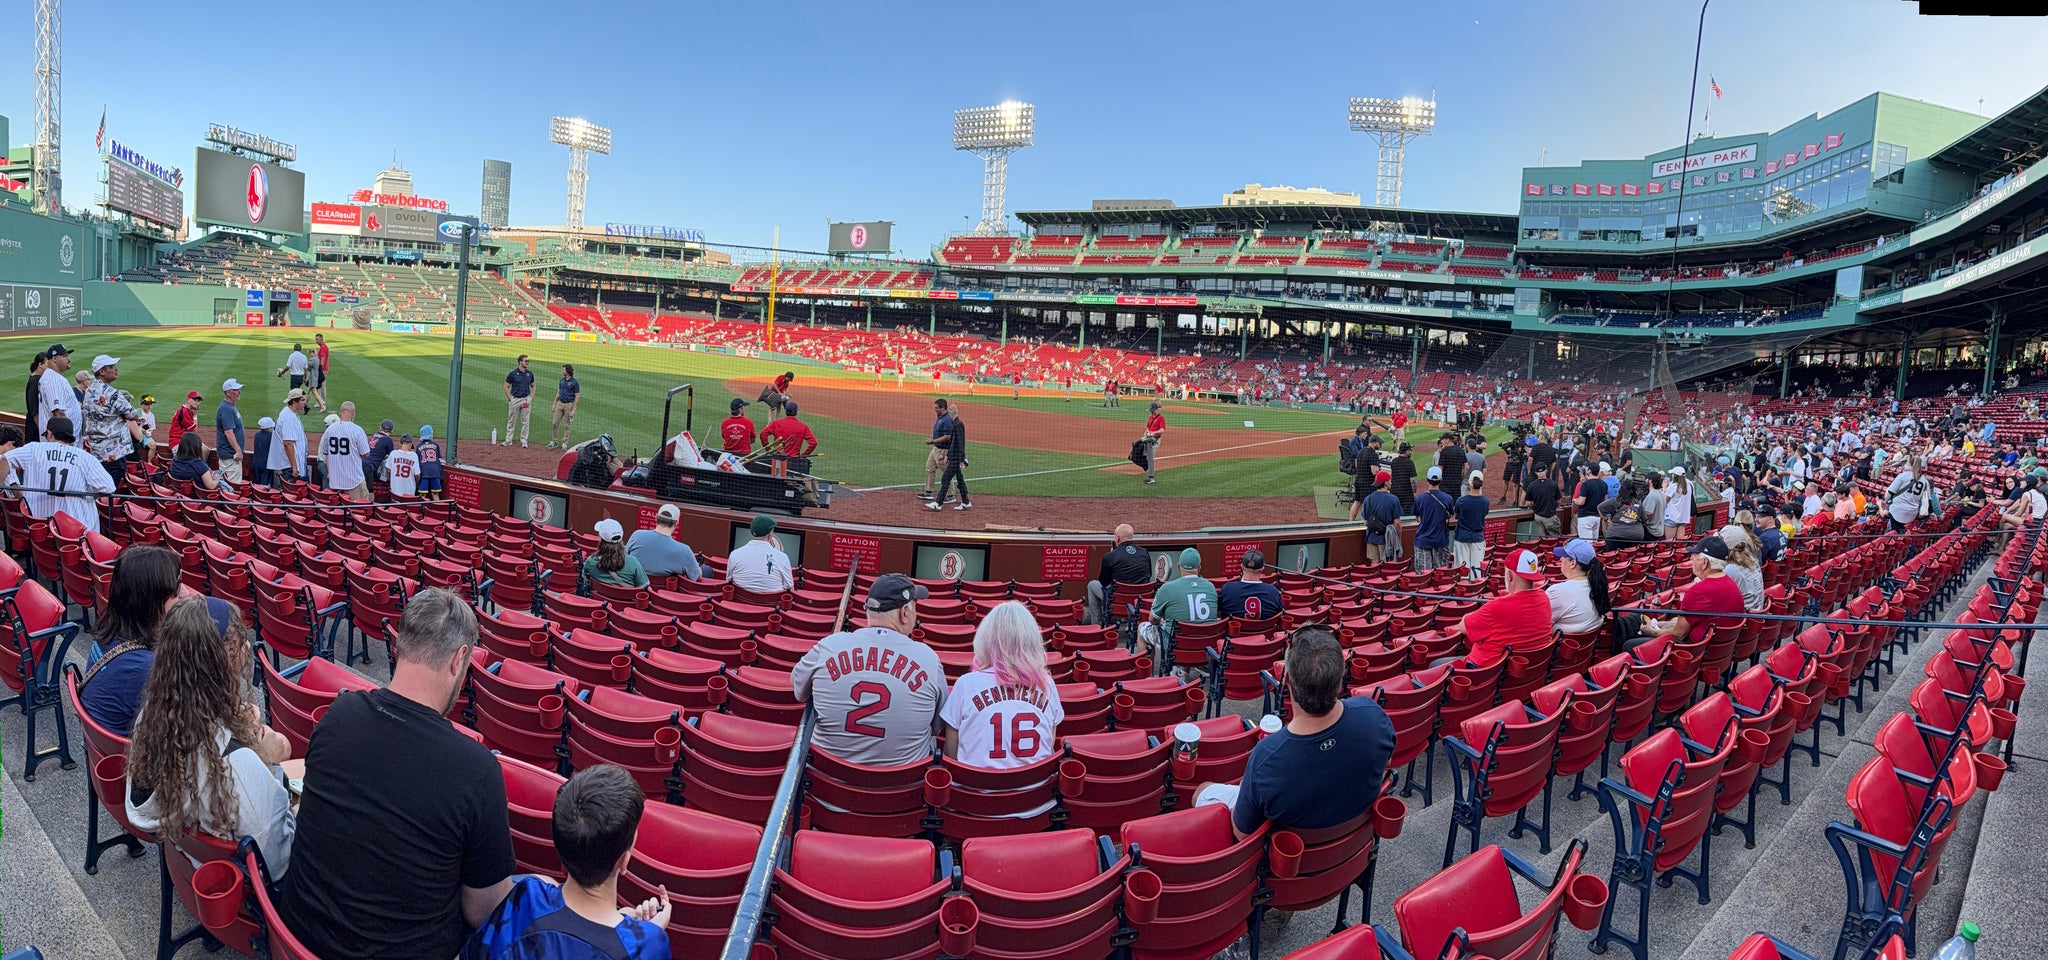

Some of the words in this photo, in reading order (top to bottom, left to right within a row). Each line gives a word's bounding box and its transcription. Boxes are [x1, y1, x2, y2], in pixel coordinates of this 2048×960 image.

[225, 124, 296, 160] MassMutual
[112, 140, 134, 164] BANK
[134, 153, 144, 169] OF
[144, 158, 173, 184] AMERICA
[1658, 156, 1706, 173] FENWAY
[1714, 149, 1748, 164] PARK
[1961, 202, 1982, 221] WELCOME
[1983, 198, 1990, 208] TO
[1990, 187, 2011, 206] FENWAY
[2011, 174, 2027, 190] PARK
[316, 210, 356, 219] CLEAResult
[395, 213, 428, 223] evolv
[605, 223, 654, 237] SAMUEL
[662, 226, 703, 242] ADAMS
[1944, 273, 1966, 289] AMERICA'S
[1966, 268, 1977, 282] MOST
[1979, 259, 2000, 277] BELOVED
[2002, 246, 2031, 267] BALLPARK
[60, 296, 75, 307] ACE
[61, 307, 75, 315] TICKET
[329, 436, 350, 455] 99
[46, 450, 78, 465] VOLPE
[394, 458, 415, 467] ANTHONY
[395, 464, 411, 478] 19
[449, 474, 480, 485] CAUTION!
[48, 466, 69, 497] 11
[1907, 479, 1923, 495] 19
[534, 500, 546, 519] B
[835, 537, 878, 546] CAUTION!
[944, 555, 957, 576] B
[1187, 593, 1210, 621] 16
[1245, 596, 1261, 620] 9
[825, 646, 928, 692] BOGAERTS
[845, 680, 891, 738] 2
[989, 712, 1040, 758] 16
[1661, 787, 1670, 796] E
[1918, 831, 1926, 841] F
